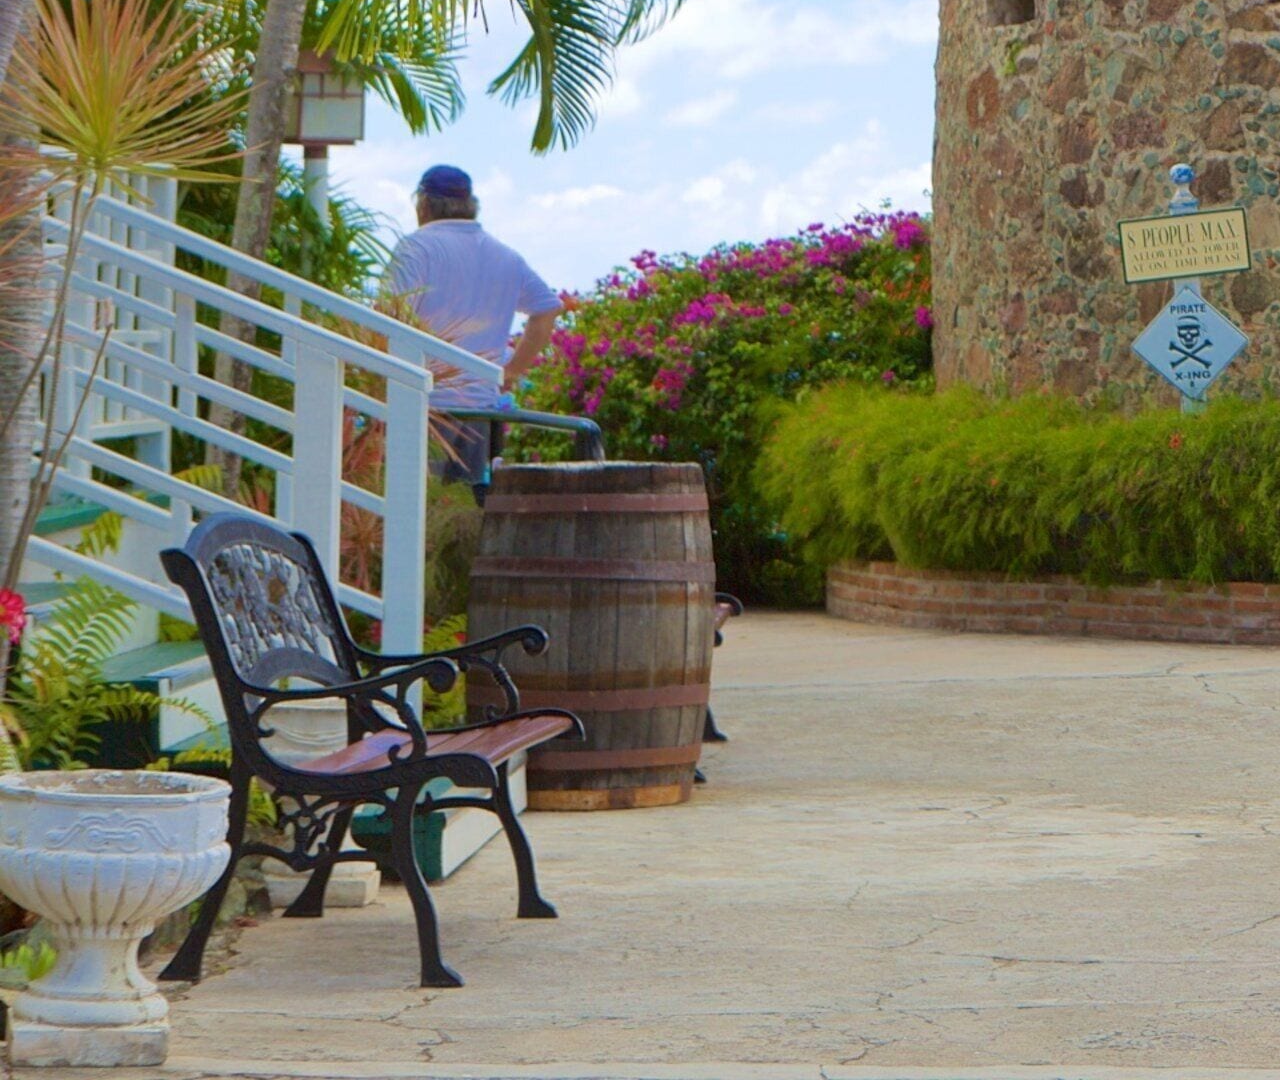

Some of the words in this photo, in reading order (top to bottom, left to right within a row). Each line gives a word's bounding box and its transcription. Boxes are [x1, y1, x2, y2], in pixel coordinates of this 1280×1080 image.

[1141, 223, 1195, 248] PEOPLE
[1133, 247, 1183, 262] ALLOWED
[1187, 245, 1198, 255] IN
[1202, 241, 1240, 254] TOWER
[1148, 260, 1168, 271] ONE
[1174, 257, 1197, 269] TIME
[1203, 252, 1240, 266] PLEASE
[1169, 304, 1207, 315] PIRATE
[1174, 370, 1212, 380] X-ING
